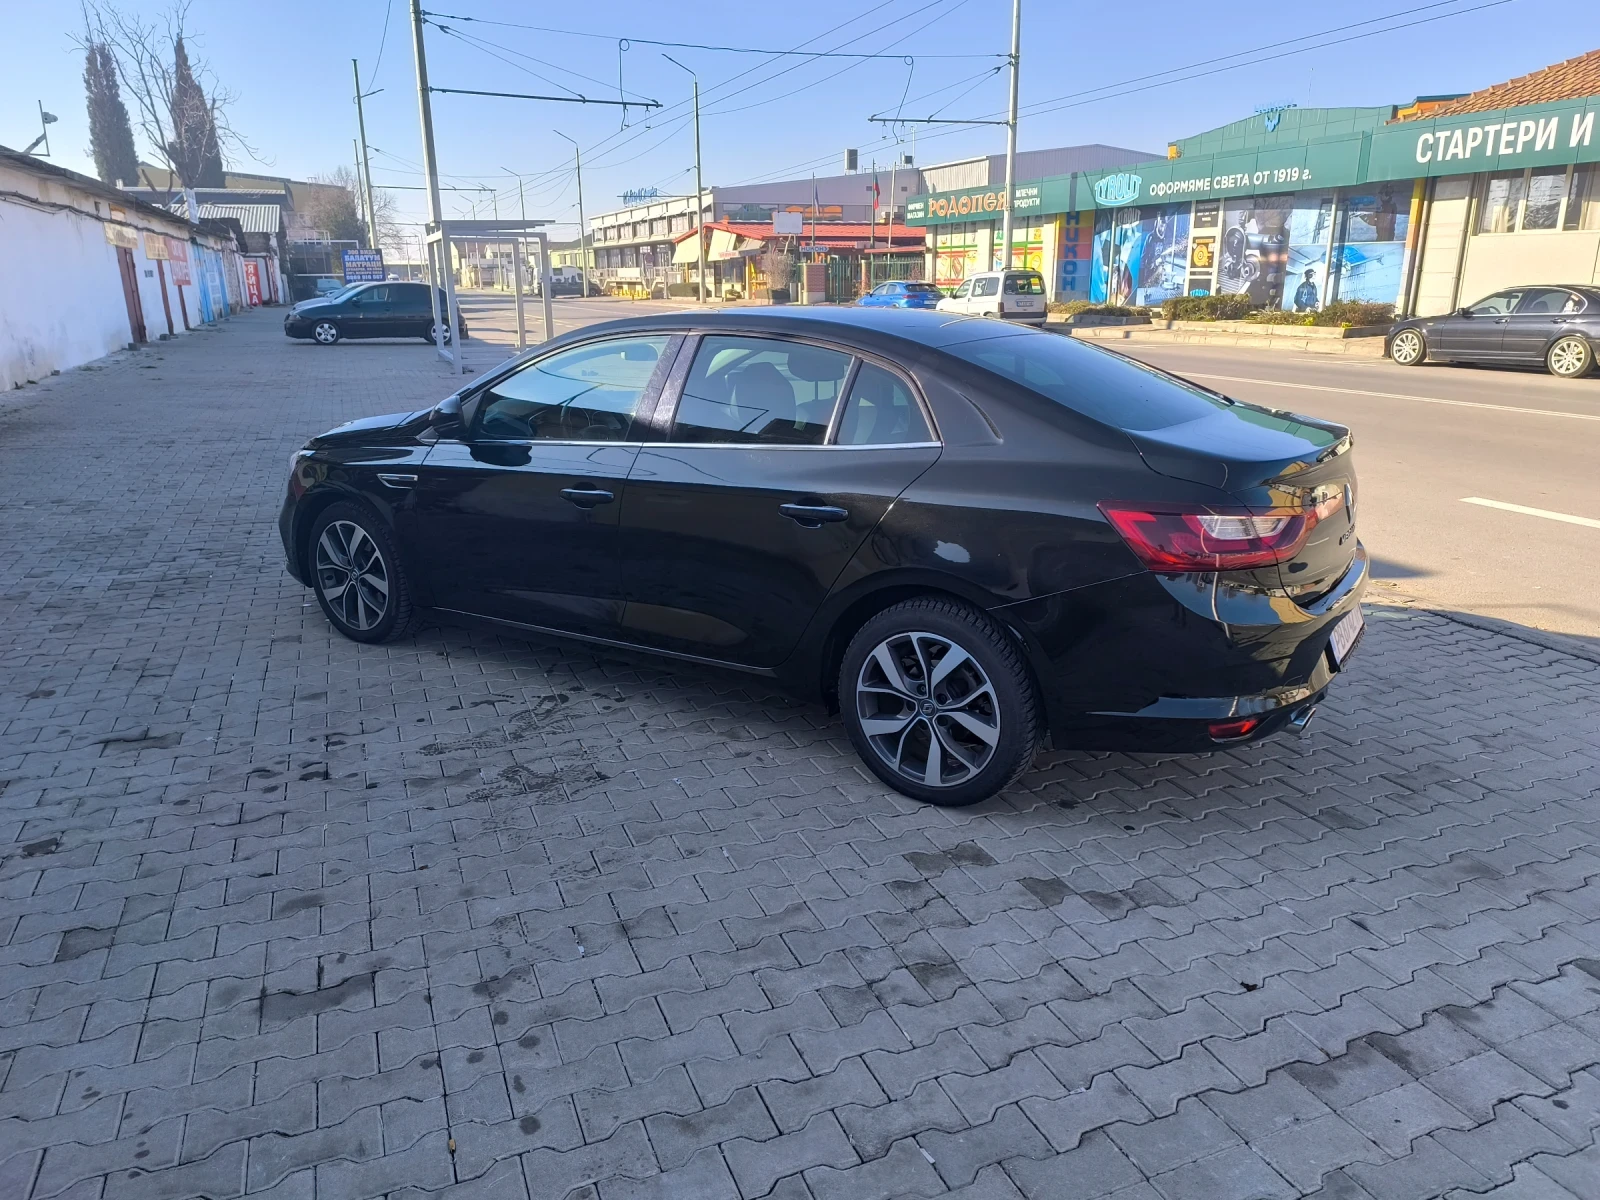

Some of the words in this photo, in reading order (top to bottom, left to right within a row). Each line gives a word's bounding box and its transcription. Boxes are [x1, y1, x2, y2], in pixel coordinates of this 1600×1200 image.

[1415, 116, 1559, 164] СТАРТЕРИ
[1569, 111, 1595, 148] И
[1095, 172, 1142, 200] TYROLIT
[1149, 177, 1211, 197] ОФОРМЯМЕ
[1213, 173, 1250, 190] СВЕТА
[1253, 170, 1271, 185] ОТ
[1273, 166, 1300, 183] 1919
[247, 264, 259, 304] ЯЙЦА
